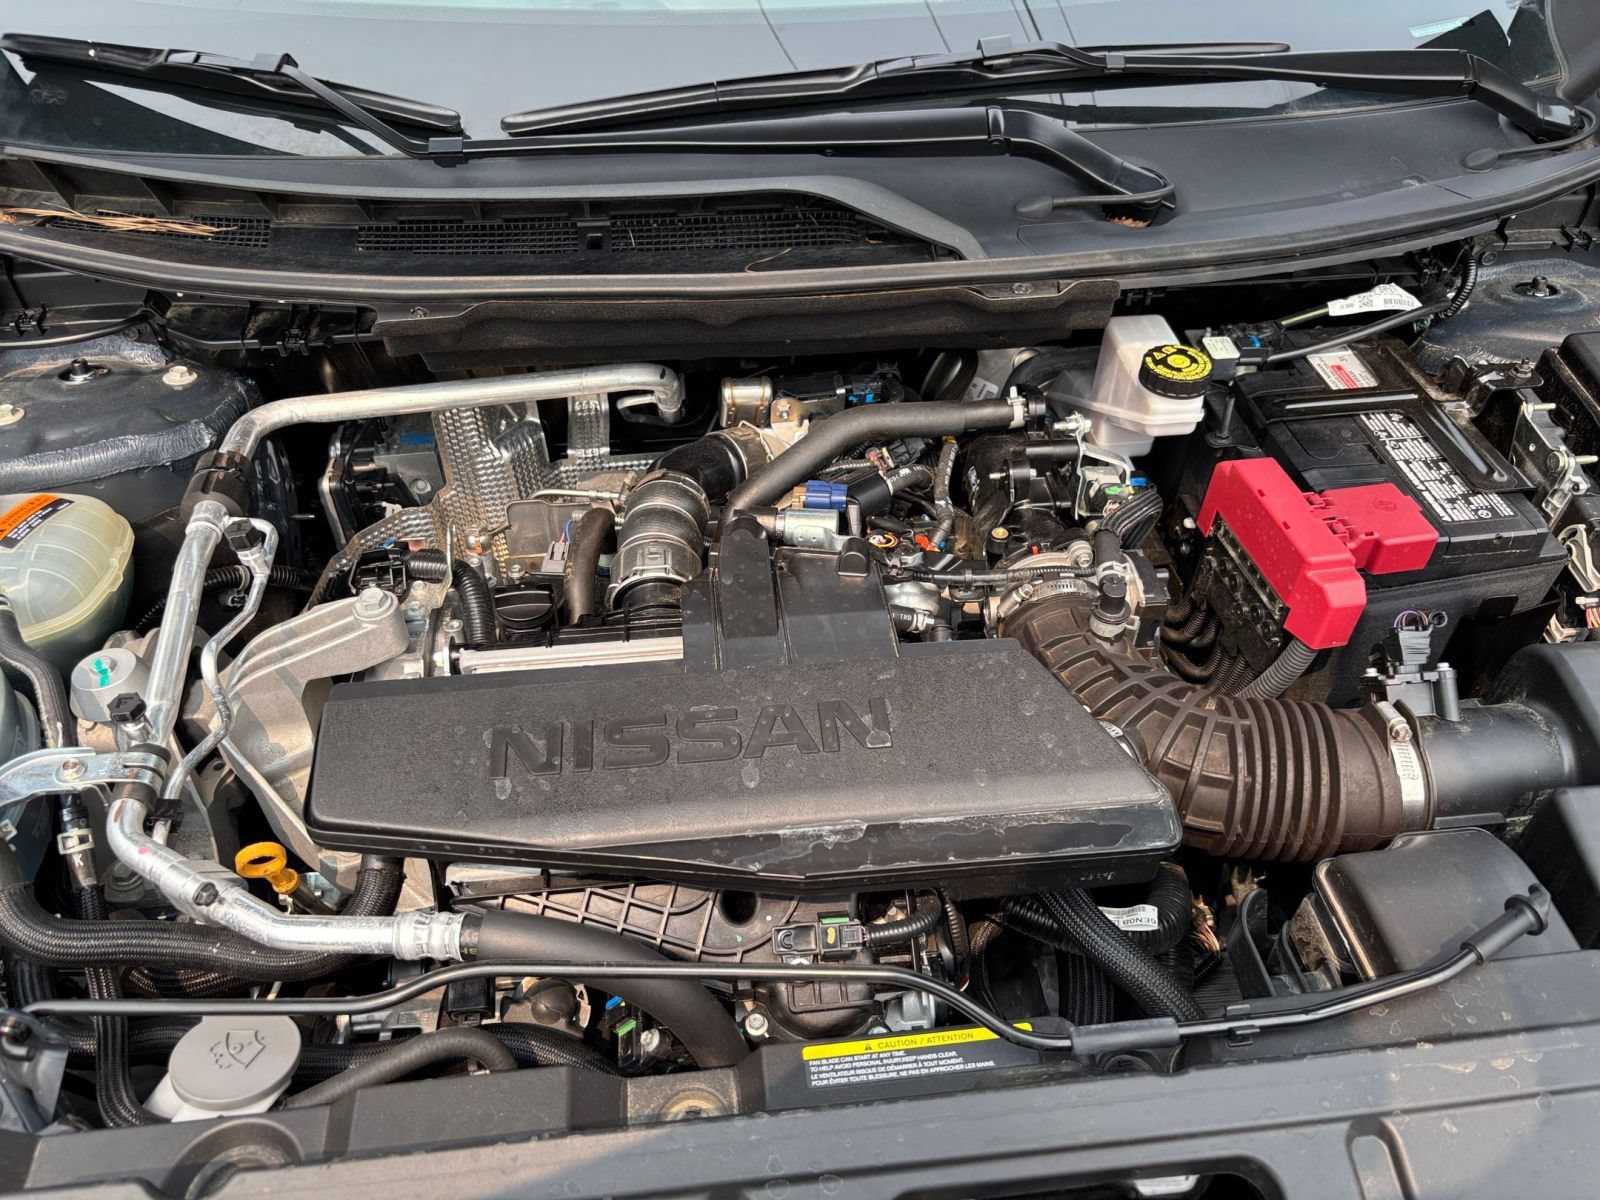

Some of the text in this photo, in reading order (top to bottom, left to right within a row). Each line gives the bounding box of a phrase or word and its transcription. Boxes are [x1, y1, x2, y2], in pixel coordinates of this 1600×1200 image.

[486, 698, 893, 780] NISSAN
[878, 1039, 917, 1049] CAUTION
[927, 1032, 974, 1044] ATTENTION
[852, 1059, 883, 1067] PERSONAL
[917, 1053, 938, 1061] HANDS
[819, 1069, 855, 1078] VENTILATEUR
[929, 1063, 965, 1072] APPROCHER
